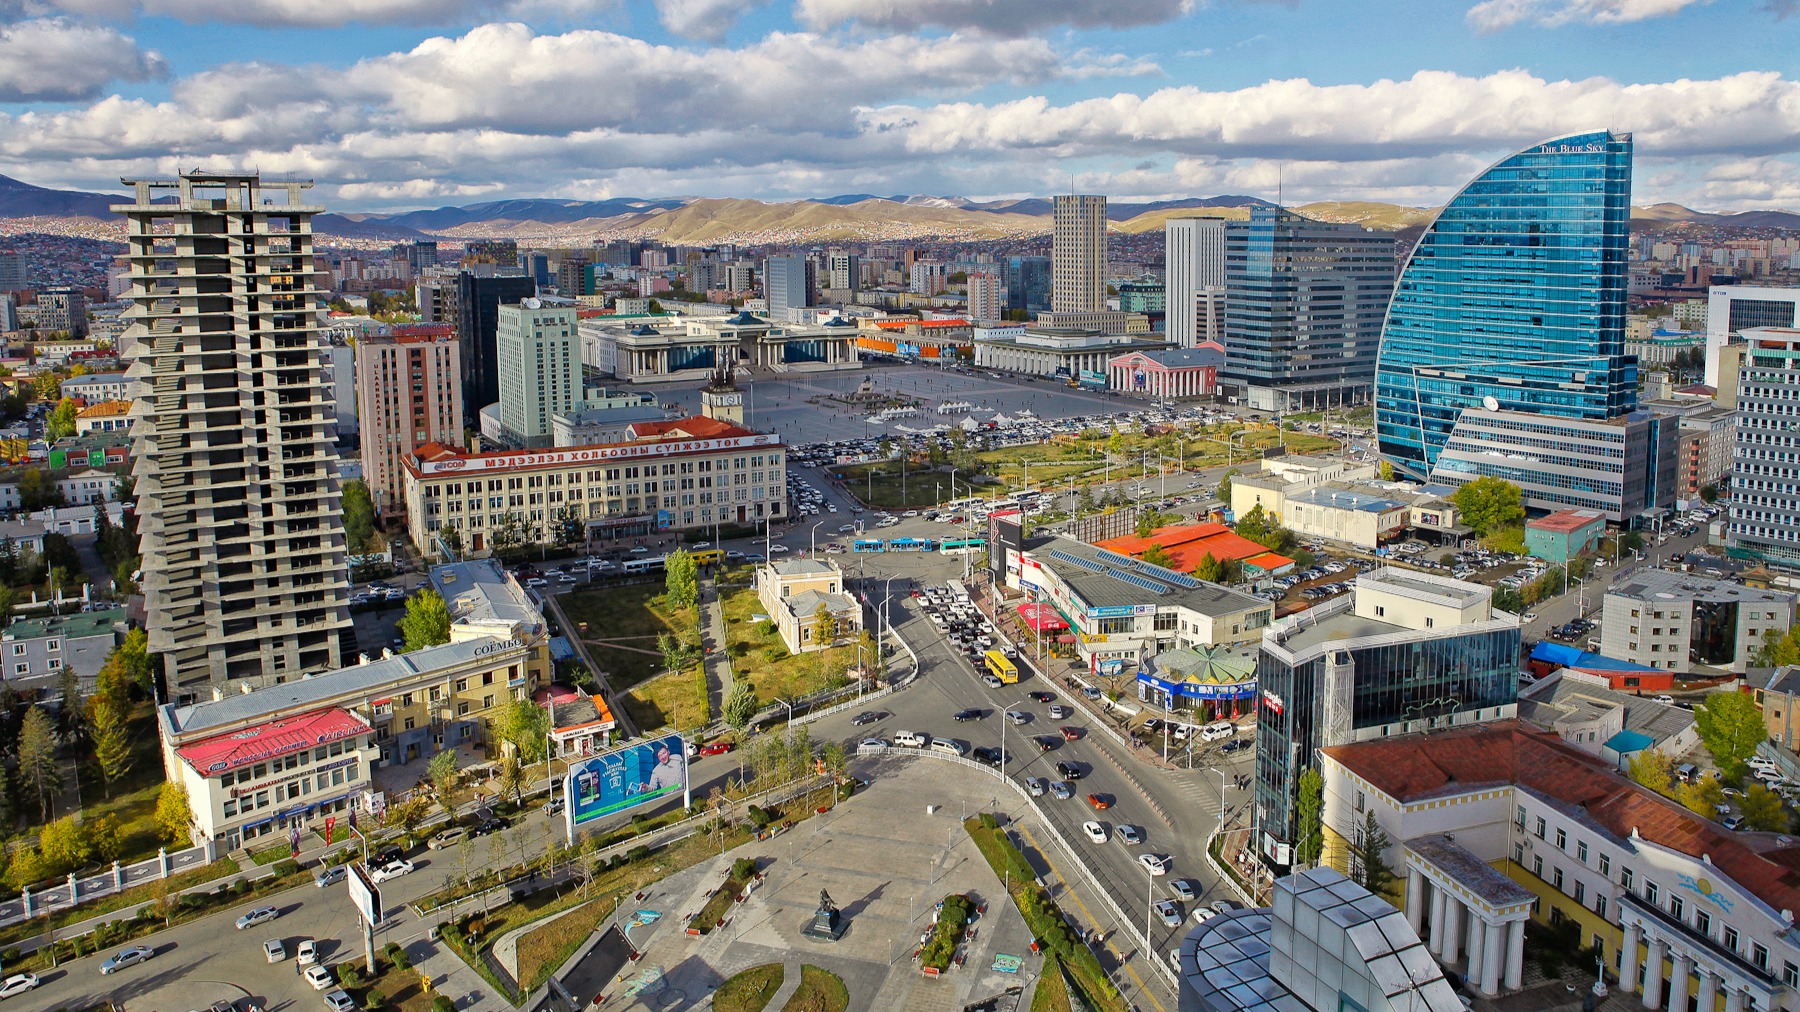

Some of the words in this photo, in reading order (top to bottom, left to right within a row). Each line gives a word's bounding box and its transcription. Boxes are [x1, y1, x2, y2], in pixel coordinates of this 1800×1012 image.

[373, 364, 382, 427] ULAANBAATAR
[485, 453, 564, 467] МЭДЭЭЛЭЛ
[571, 446, 649, 460] ХОЛБООНЫ
[655, 441, 710, 453] СҮЛЖЭЭ
[716, 438, 741, 447] ТӨК
[474, 637, 522, 655] СОЁМБО
[325, 724, 365, 741] AIRLINK
